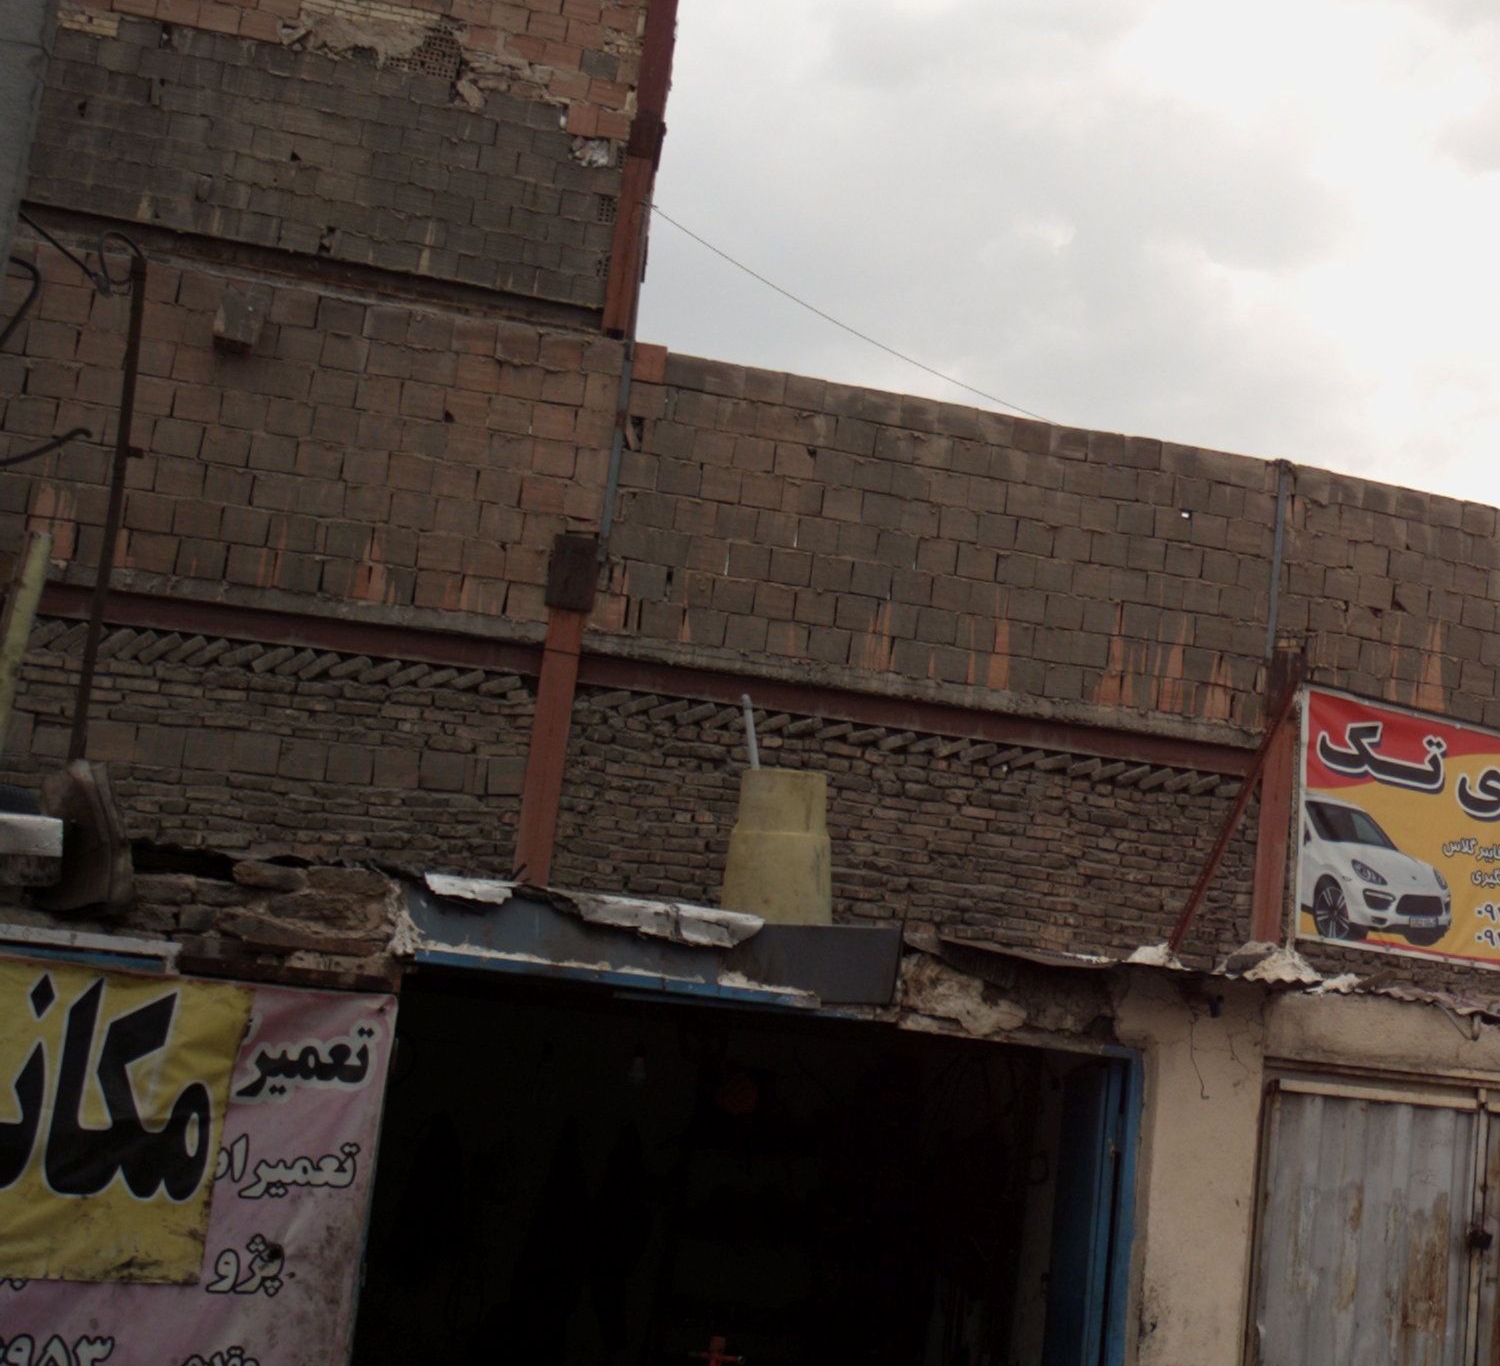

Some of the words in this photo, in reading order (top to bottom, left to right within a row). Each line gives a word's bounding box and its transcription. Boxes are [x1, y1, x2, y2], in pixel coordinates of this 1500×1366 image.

[1318, 723, 1446, 792] تک
[0, 972, 212, 1201] مکان
[206, 1233, 286, 1298] پژو
